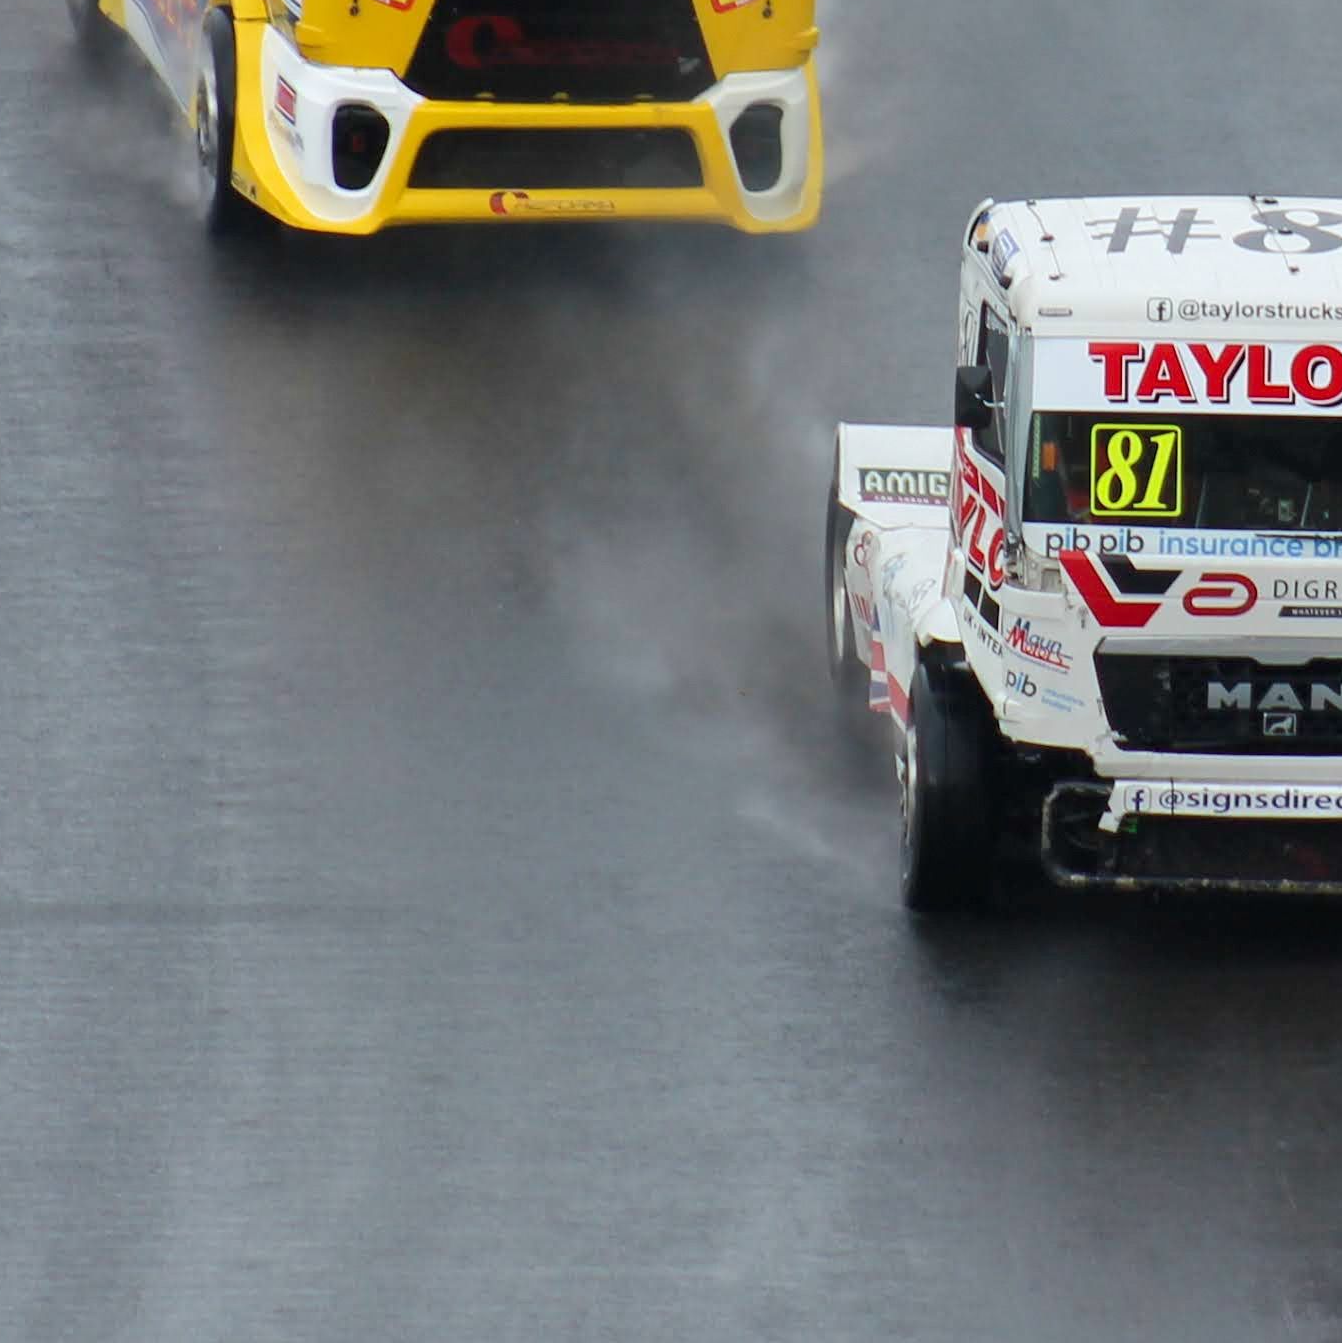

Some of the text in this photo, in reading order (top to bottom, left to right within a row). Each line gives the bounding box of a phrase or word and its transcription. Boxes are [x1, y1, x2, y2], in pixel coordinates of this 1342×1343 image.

[1095, 429, 1178, 511] 81
[1045, 530, 1091, 557] pib
[1099, 531, 1145, 560] pib
[1159, 529, 1304, 558] insurance
[1005, 669, 1038, 697] pib
